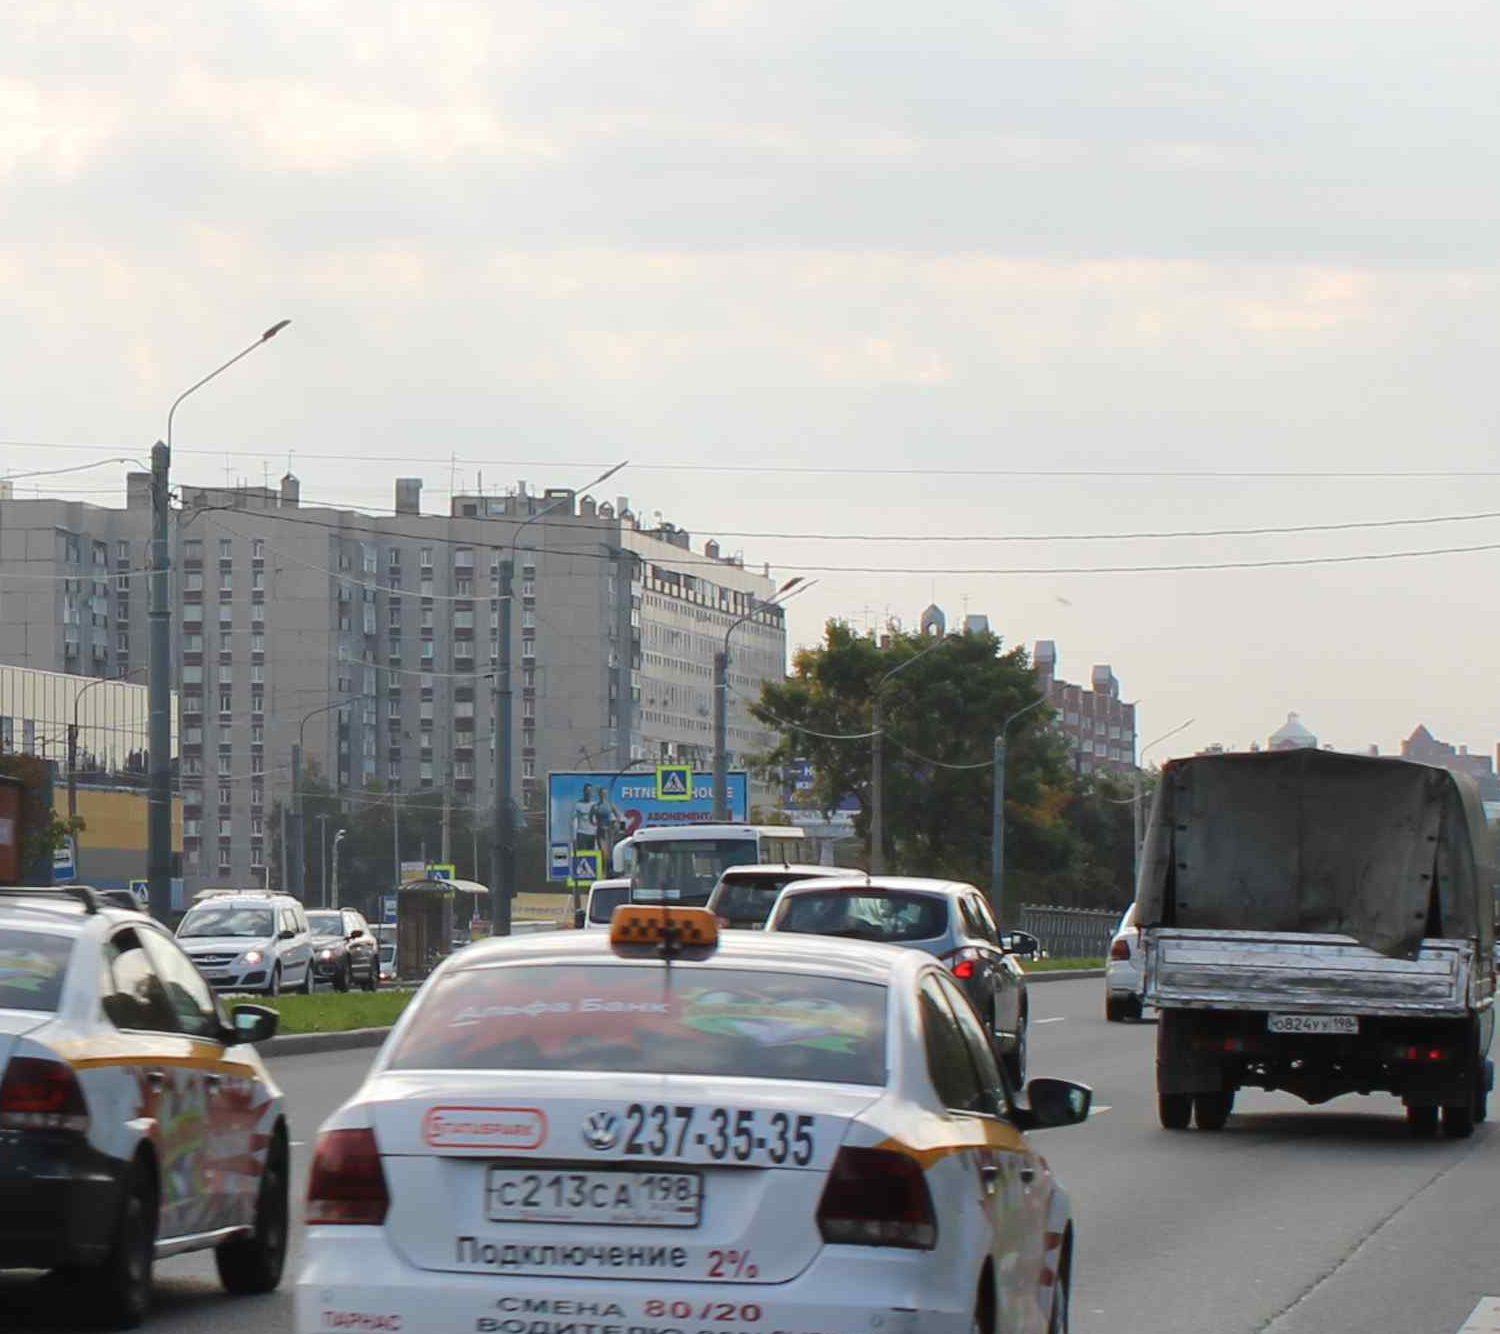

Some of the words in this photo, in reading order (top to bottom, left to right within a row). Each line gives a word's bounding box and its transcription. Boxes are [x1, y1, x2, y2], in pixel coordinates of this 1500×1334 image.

[640, 1175, 691, 1202] 198
[455, 1236, 688, 1269] Подключение
[707, 1249, 760, 1279] 2%
[497, 1296, 626, 1319] СМЕНА
[322, 1310, 402, 1332] ПАРНАС
